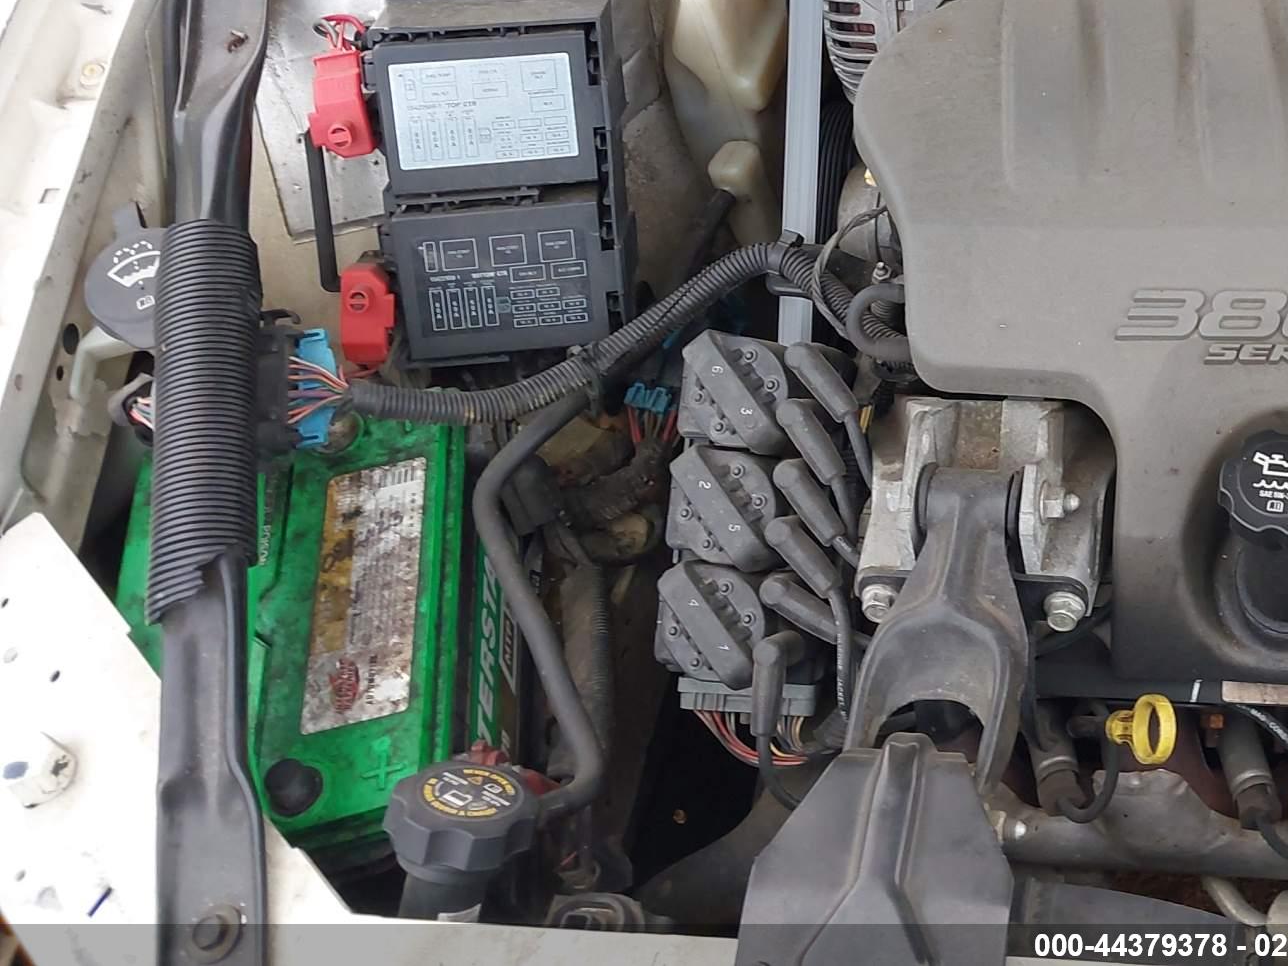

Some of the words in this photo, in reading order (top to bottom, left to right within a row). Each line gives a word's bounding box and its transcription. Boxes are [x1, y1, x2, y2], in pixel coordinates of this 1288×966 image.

[740, 407, 753, 417] 3
[698, 479, 711, 490] 2
[728, 523, 742, 533] 5
[478, 554, 499, 747] TERSTA
